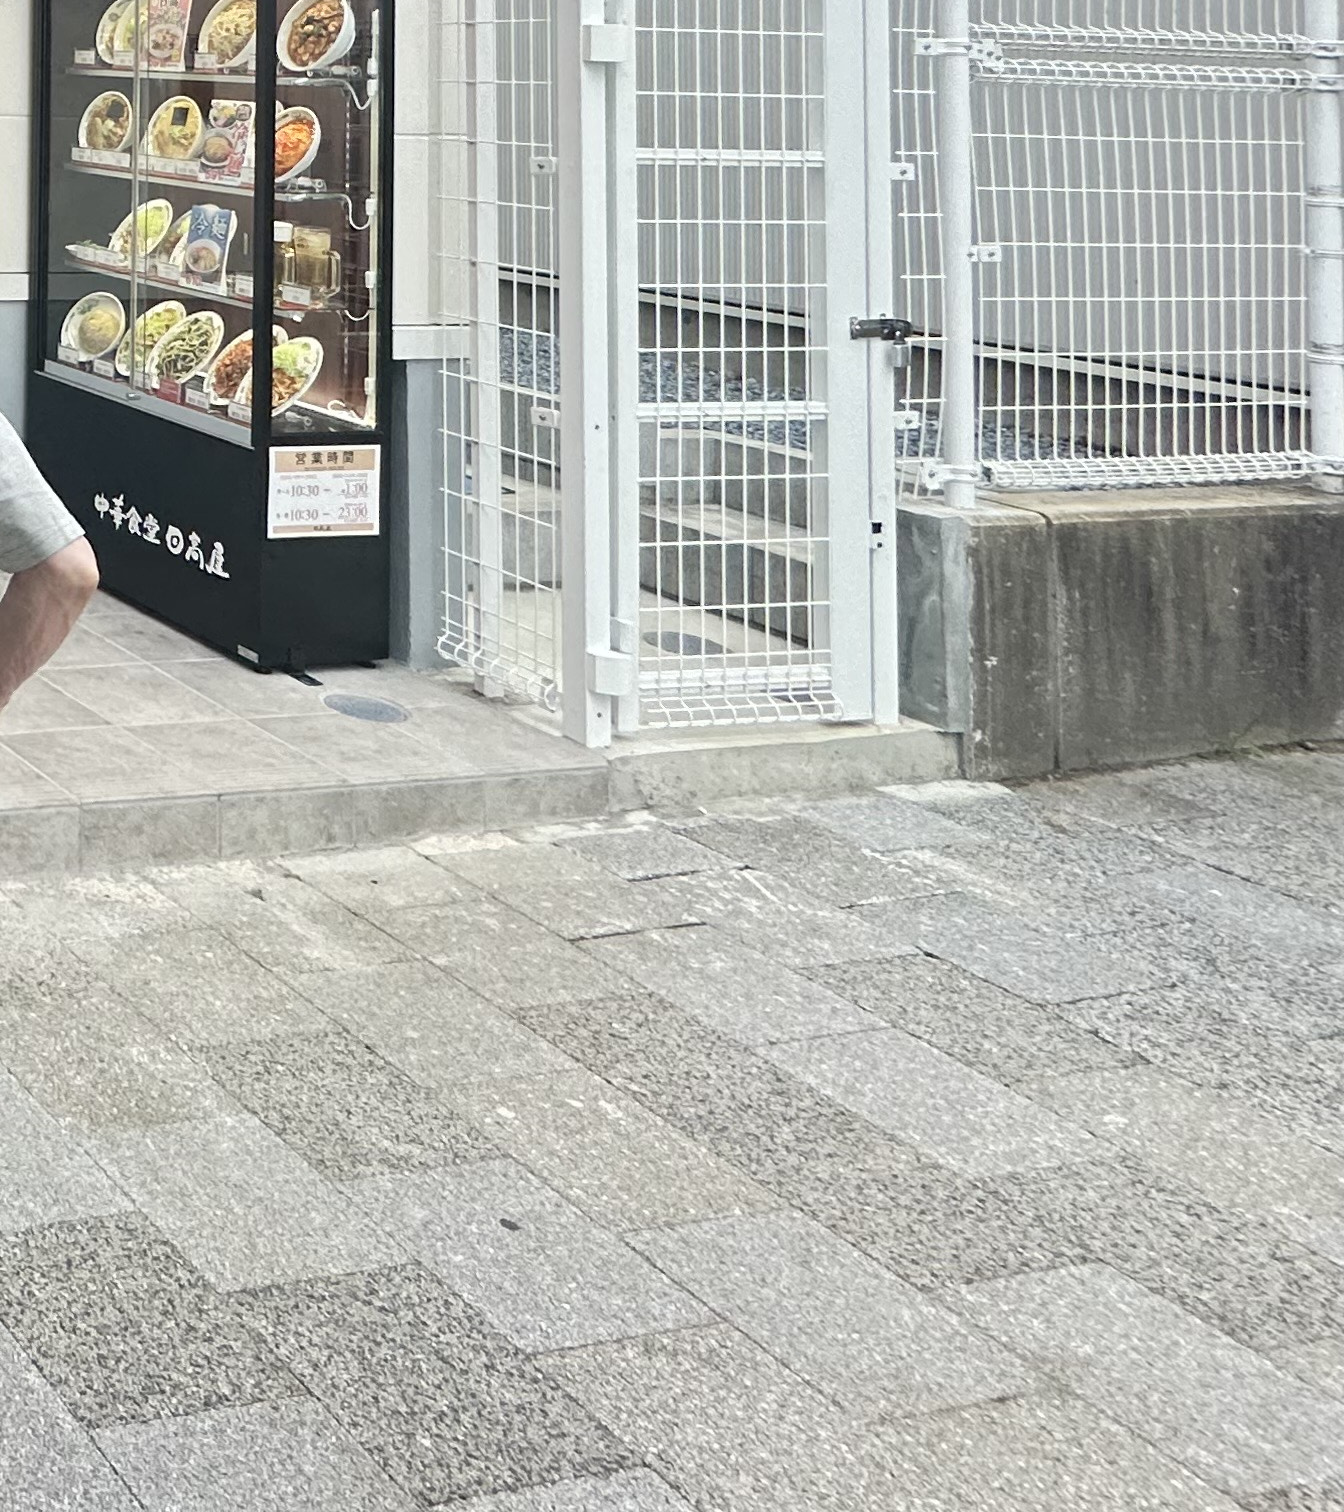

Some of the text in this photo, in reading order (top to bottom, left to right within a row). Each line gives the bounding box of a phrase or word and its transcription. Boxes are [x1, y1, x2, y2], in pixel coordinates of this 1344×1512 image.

[94, 492, 230, 579] 中華食堂 日高屋
